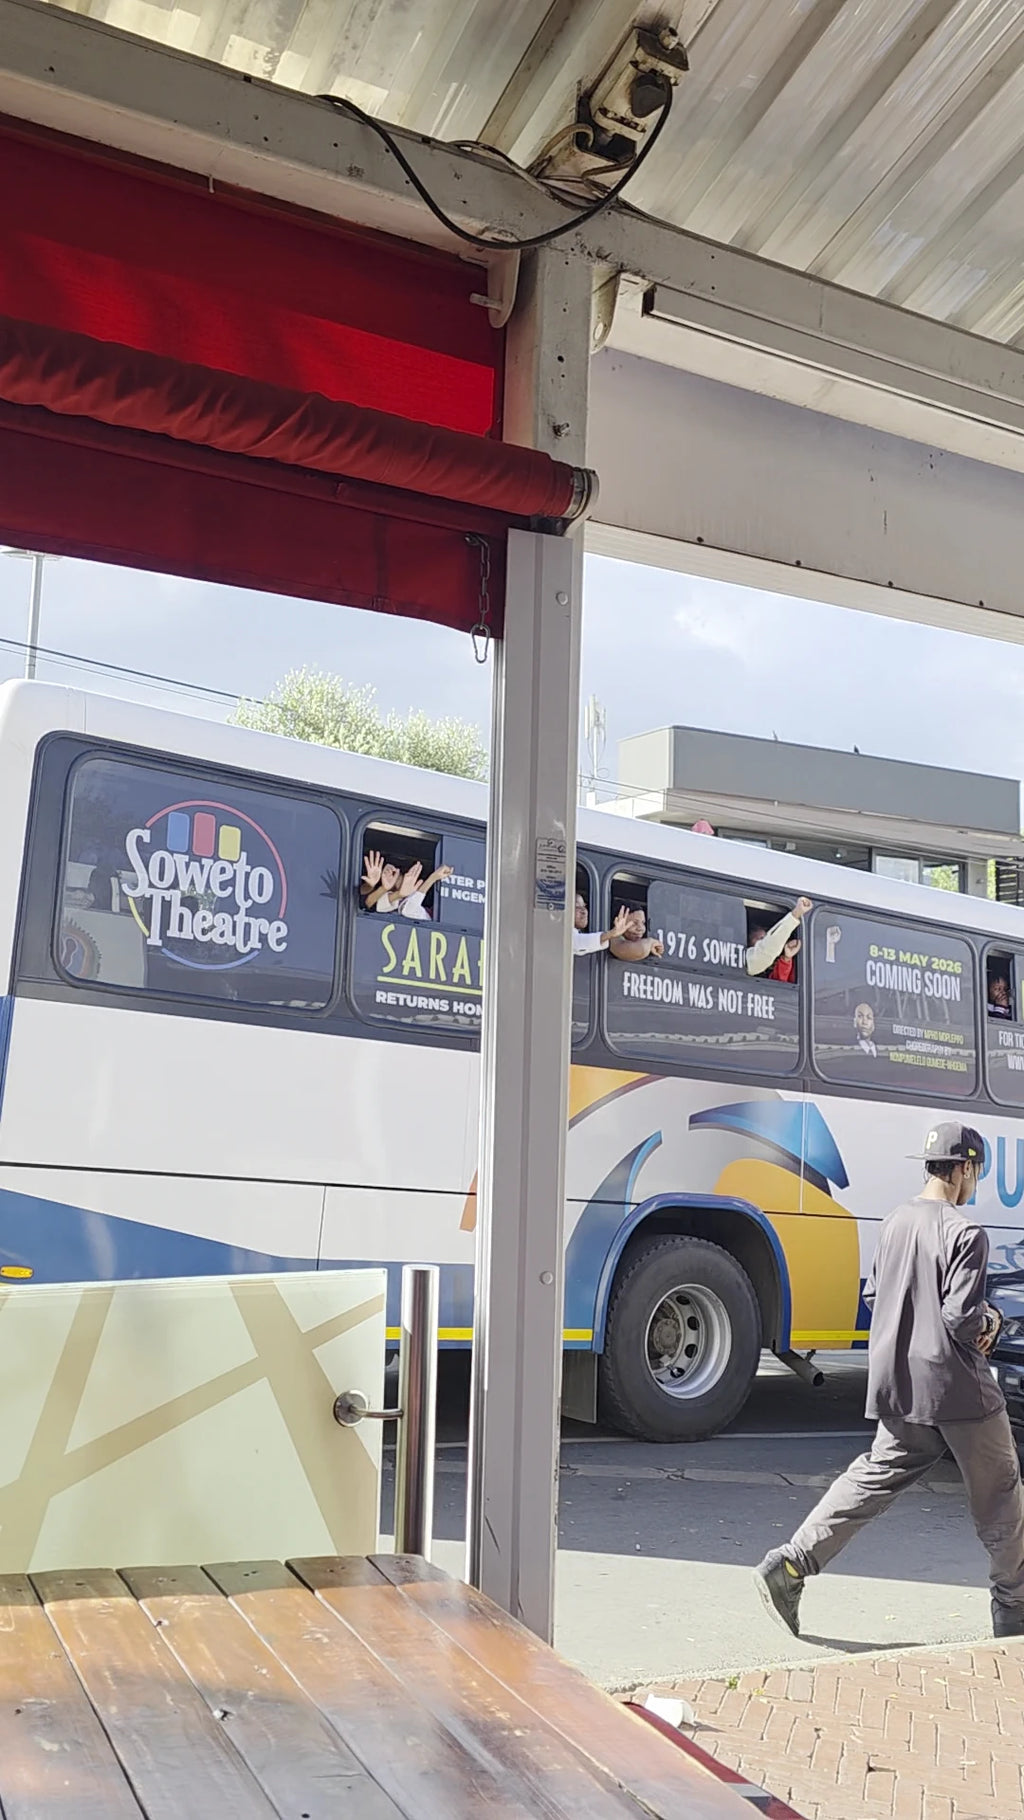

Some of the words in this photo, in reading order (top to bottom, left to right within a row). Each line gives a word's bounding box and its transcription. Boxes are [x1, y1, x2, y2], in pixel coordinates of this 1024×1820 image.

[121, 828, 274, 909] Soweto
[144, 886, 289, 954] Theatre
[656, 929, 697, 960] 1976
[702, 938, 747, 969] SOWET
[869, 944, 897, 961] 8-13
[899, 950, 929, 968] MAY
[931, 957, 963, 974] 2026
[622, 971, 684, 1006] FREEDOM
[688, 982, 714, 1010] WAS
[718, 986, 744, 1015] NOT
[747, 992, 776, 1020] FREE
[866, 959, 922, 995] COMING
[924, 970, 961, 1002] SOON
[375, 990, 450, 1012] RETURNS
[998, 1030, 1014, 1048] FOR
[1007, 1053, 1024, 1071] WW
[925, 1131, 938, 1150] P
